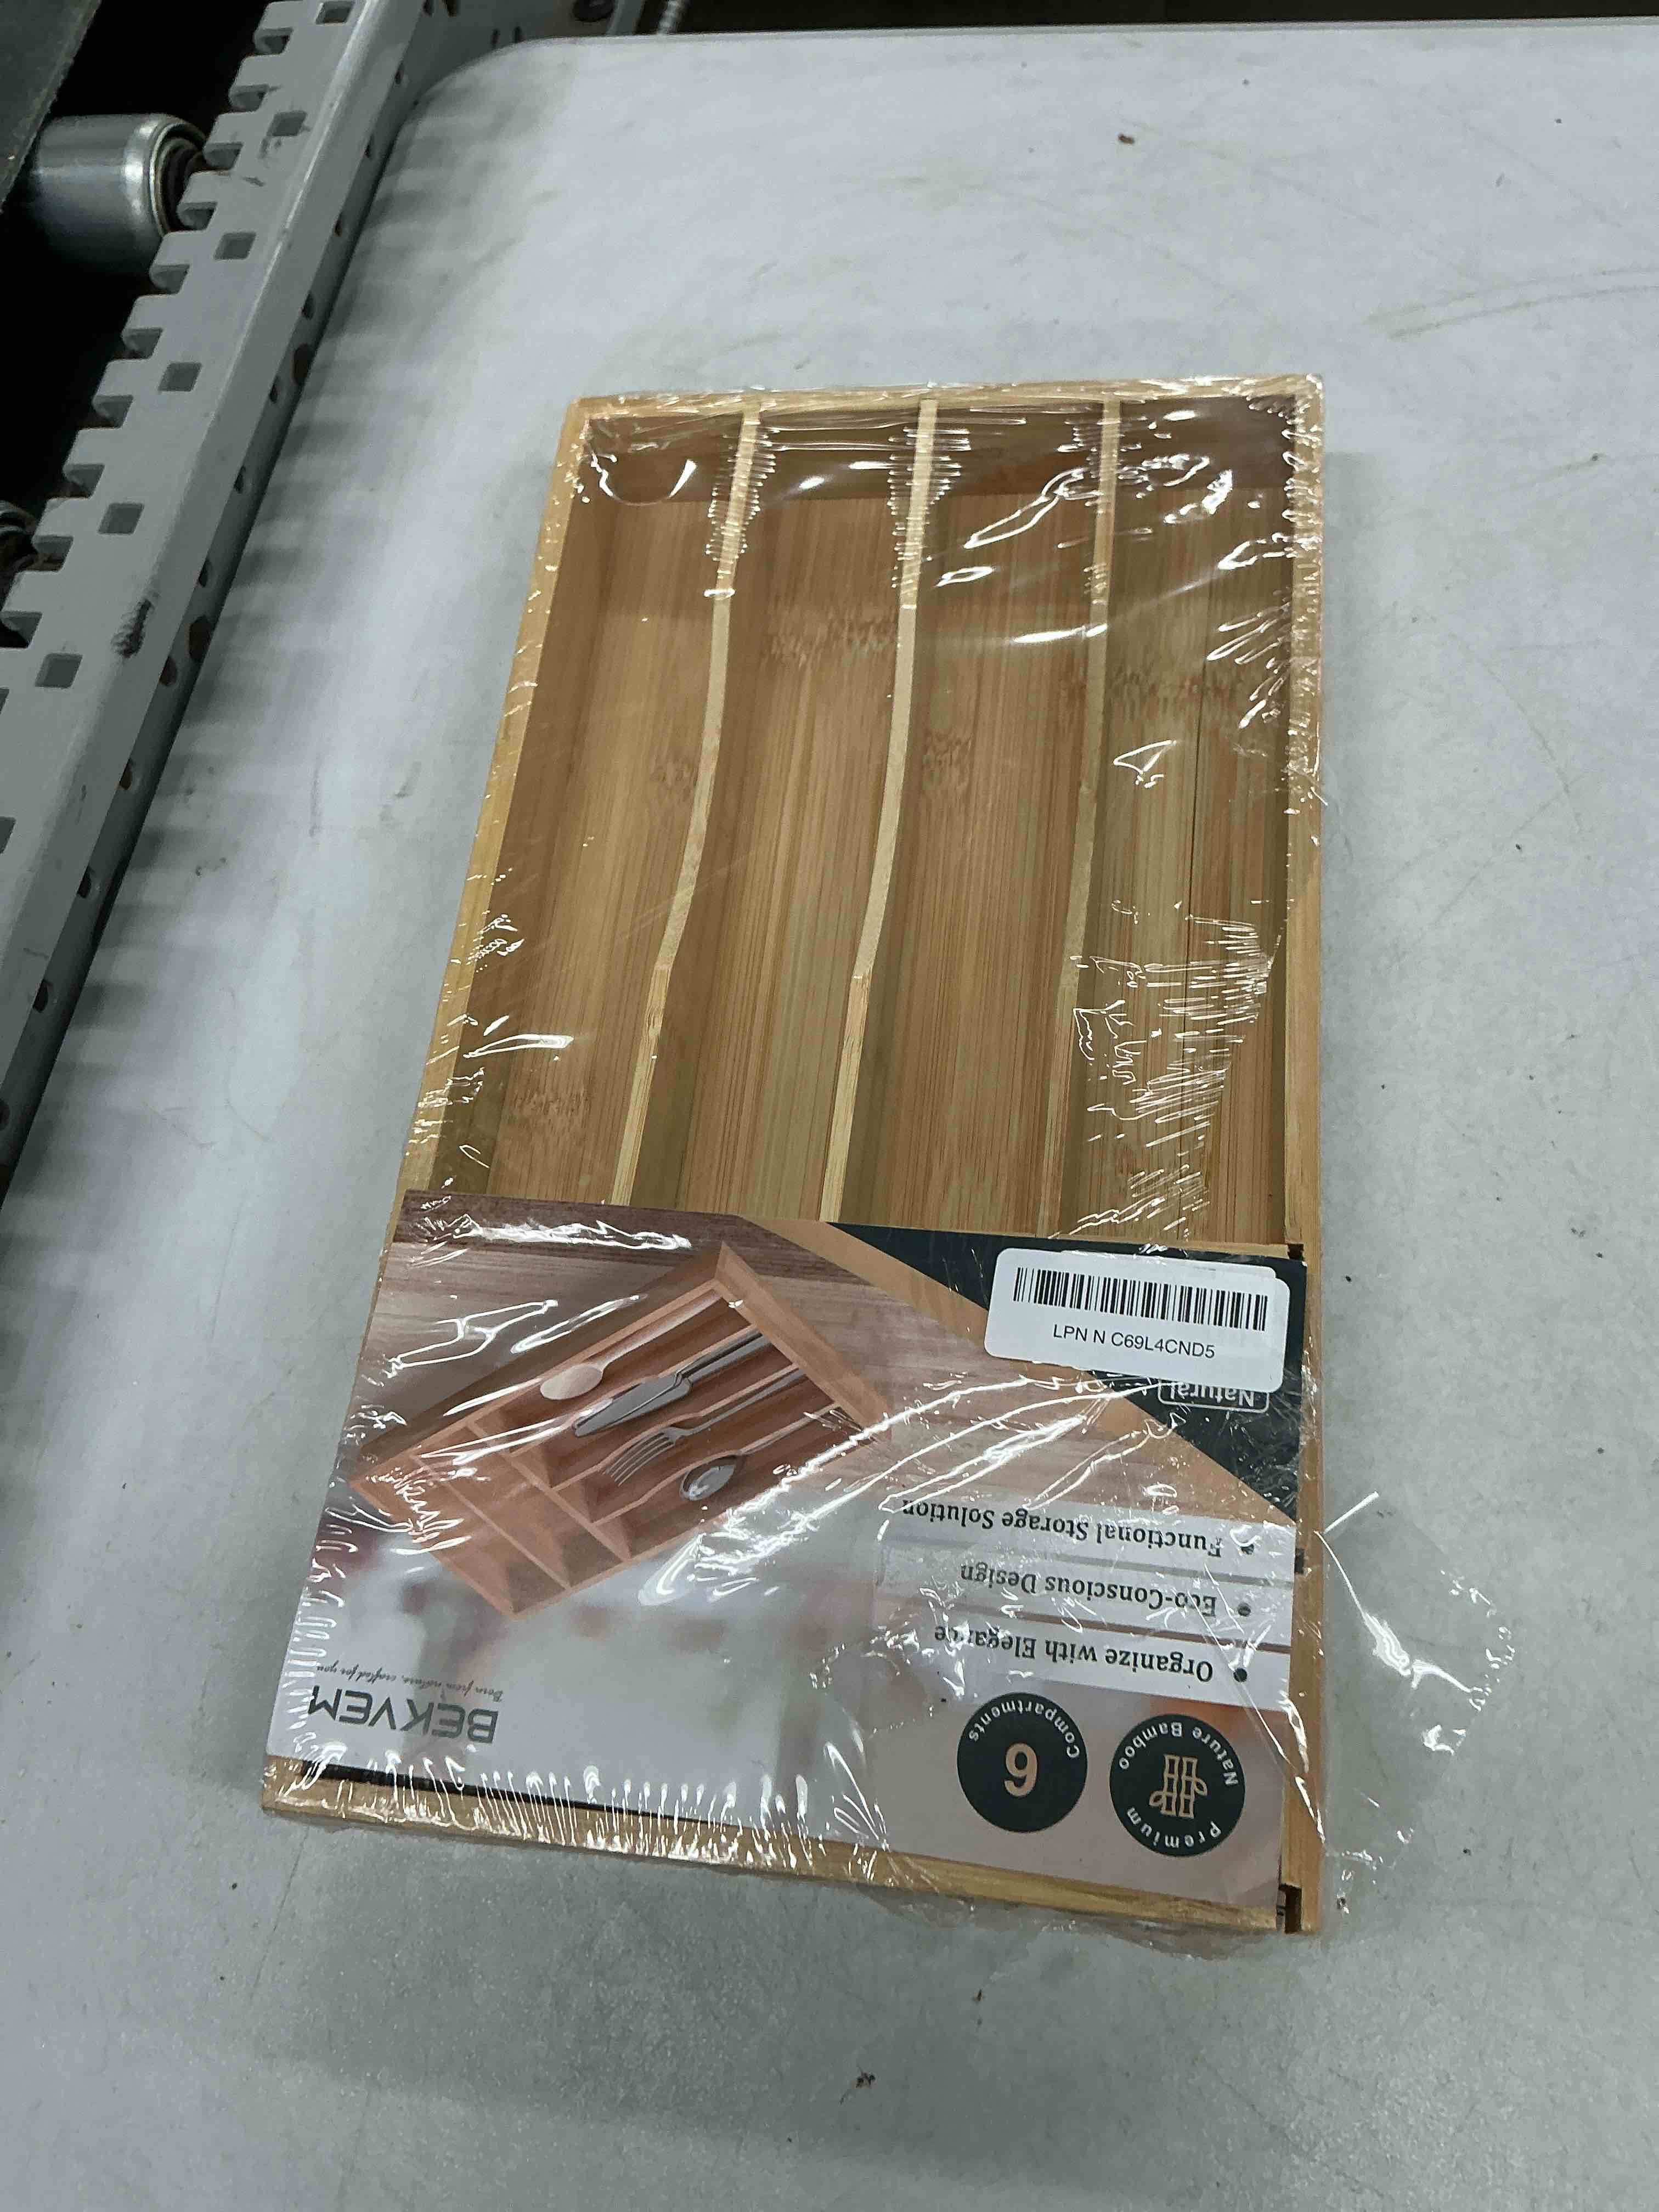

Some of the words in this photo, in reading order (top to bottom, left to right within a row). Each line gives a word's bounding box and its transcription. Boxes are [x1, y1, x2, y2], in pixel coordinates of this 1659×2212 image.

[1053, 1324, 1087, 1342] LPN
[1093, 1330, 1106, 1345] N
[1110, 1332, 1216, 1359] C69L4CND5
[902, 1499, 995, 1529] Solution
[1002, 1506, 1088, 1540] Storage
[1096, 1523, 1221, 1558] Functional
[960, 1562, 1036, 1593] Design
[1045, 1575, 1217, 1617] Eco-Conscious
[1044, 1639, 1097, 1663] with
[1105, 1648, 1214, 1683] Organize
[340, 1663, 360, 1681] for
[358, 1667, 397, 1685] crafted
[445, 1680, 474, 1697] from
[308, 1685, 499, 1743] BEKVEM
[968, 1699, 1080, 1759] Compartments
[1118, 1722, 1183, 1770] Bamboo
[1190, 1725, 1239, 1787] Nature
[1004, 1742, 1039, 1798] 6
[1126, 1807, 1222, 1849] Premium
